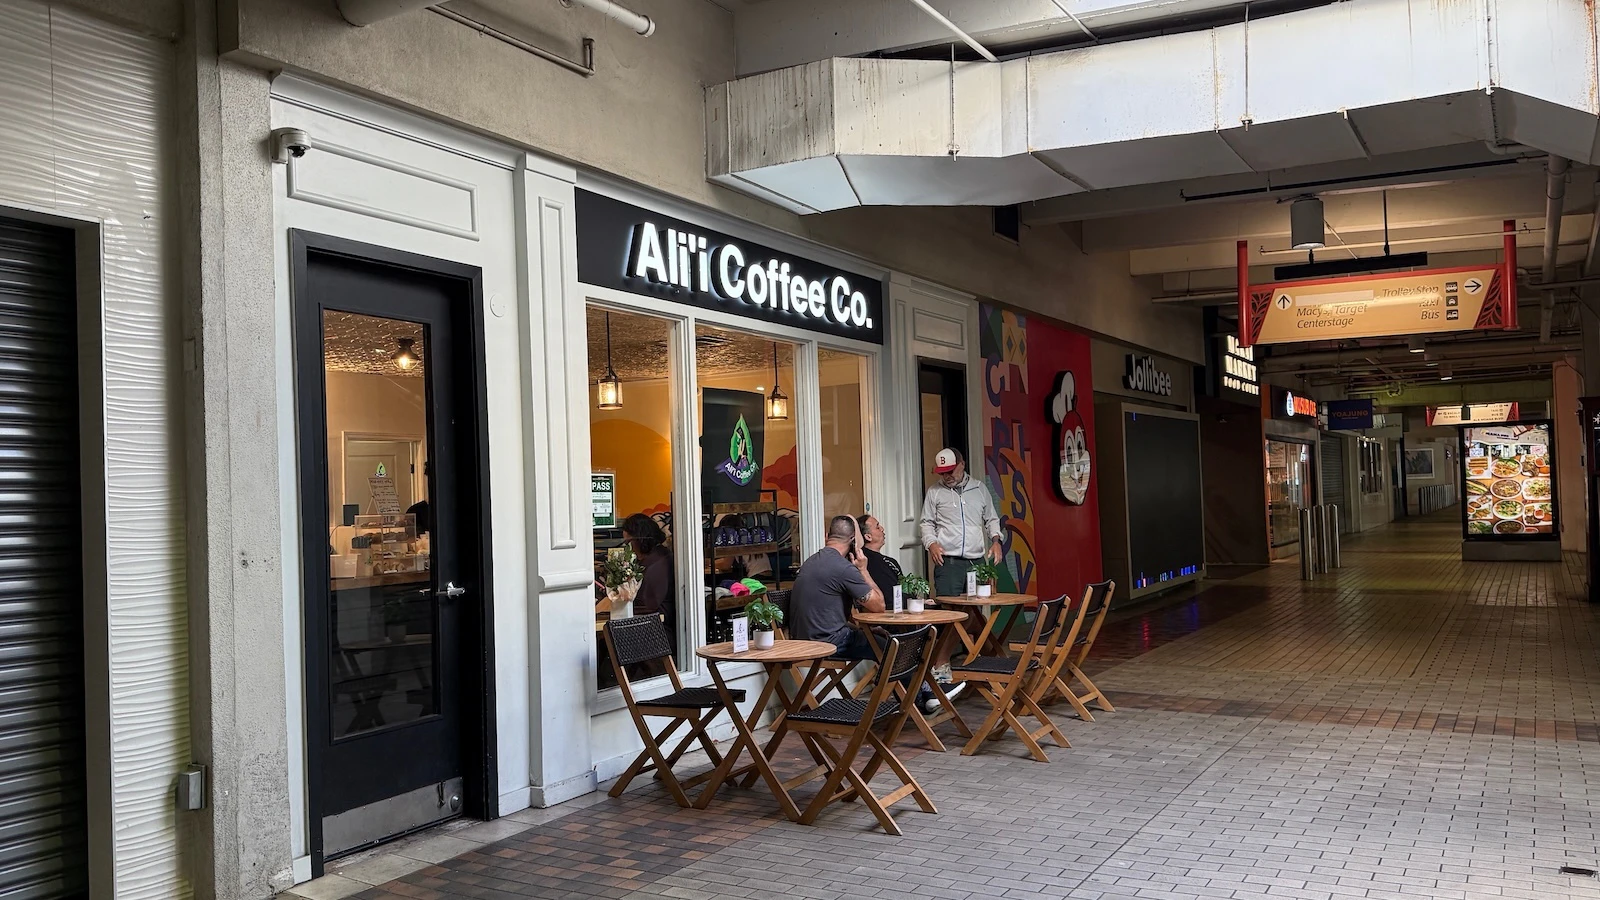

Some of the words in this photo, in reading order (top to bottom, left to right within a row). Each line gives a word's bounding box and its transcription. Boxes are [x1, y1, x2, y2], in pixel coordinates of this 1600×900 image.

[636, 221, 709, 293] Ali'i
[719, 243, 826, 318] Coffee
[830, 275, 873, 329] Co.
[1382, 287, 1415, 297] Trolley
[1416, 285, 1439, 295] Stop
[1296, 306, 1330, 318] Macys,
[1335, 303, 1368, 316] Target
[1420, 310, 1440, 320] Bus
[1296, 317, 1354, 329] Centerstage
[1225, 354, 1257, 382] MARKET
[1128, 353, 1172, 397] Jollibee
[1223, 376, 1241, 390] FOOD
[1241, 382, 1259, 395] COURT
[940, 456, 946, 465] B
[736, 469, 751, 480] Coffee
[592, 481, 611, 491] PASS
